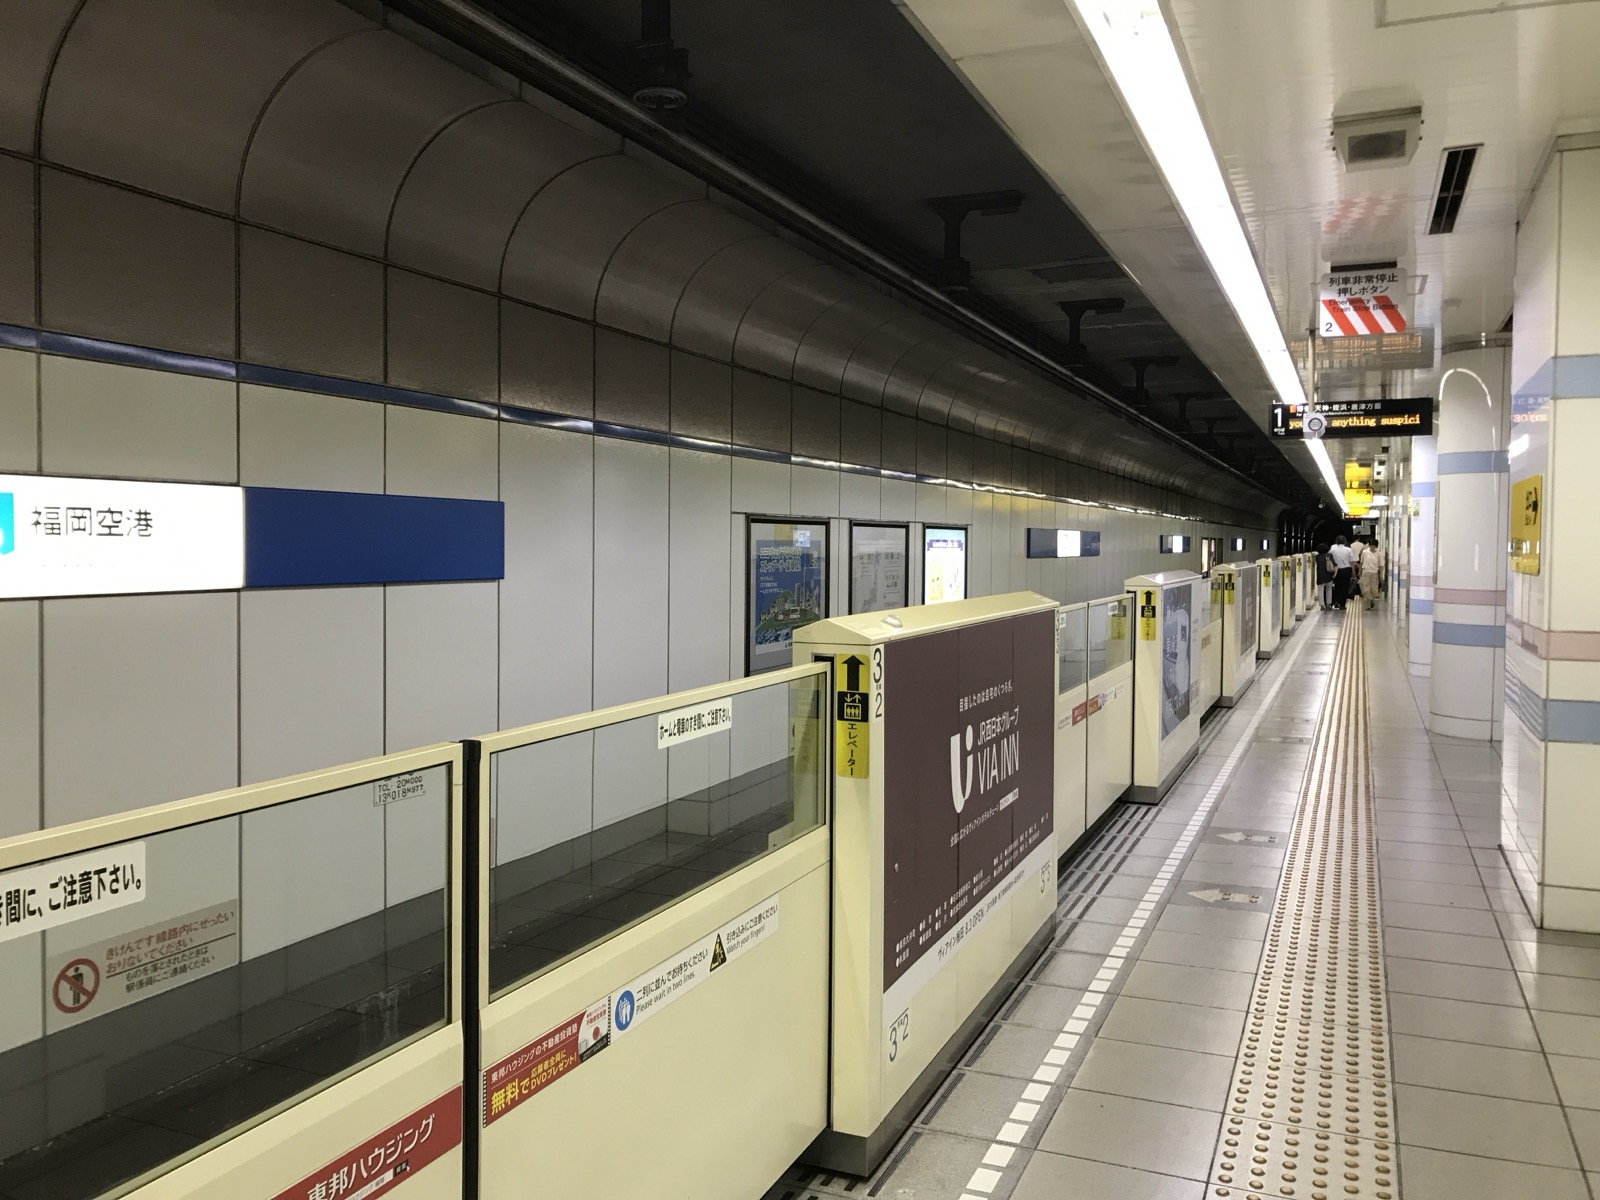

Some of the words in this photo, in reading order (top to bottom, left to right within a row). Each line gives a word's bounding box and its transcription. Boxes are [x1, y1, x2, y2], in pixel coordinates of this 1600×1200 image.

[1329, 273, 1398, 287] 列車非常停止
[1337, 285, 1389, 297] 押しボタン
[1329, 299, 1370, 307] Emergency
[1373, 303, 1399, 311] Button
[1325, 322, 1333, 332] 2
[1274, 408, 1282, 428] 1
[1332, 415, 1376, 427] anything
[1381, 414, 1420, 426] suspici
[31, 506, 153, 537] 福岡空港
[873, 648, 882, 683] 3
[876, 692, 882, 718] 2
[977, 705, 1019, 746] JR西日本グループ
[847, 723, 858, 776] エレベーター
[978, 743, 999, 794] VIA
[1000, 731, 1019, 781] INN
[105, 937, 193, 974] おりないでください
[126, 946, 208, 982] ものを落とされたときは
[125, 956, 215, 993] 駅係員にご連絡ください
[637, 949, 708, 1002] 二列に並んでお待ちください
[636, 998, 653, 1015] Please
[654, 989, 666, 1003] wait
[666, 986, 672, 995] in
[672, 980, 683, 991] two
[491, 1022, 578, 1084] 東邦ハウジングの不動産投資塾
[889, 1026, 897, 1062] 3
[902, 1013, 909, 1041] 2
[491, 1078, 530, 1116] 無料で
[308, 1113, 436, 1200] 東邦ハウジング
